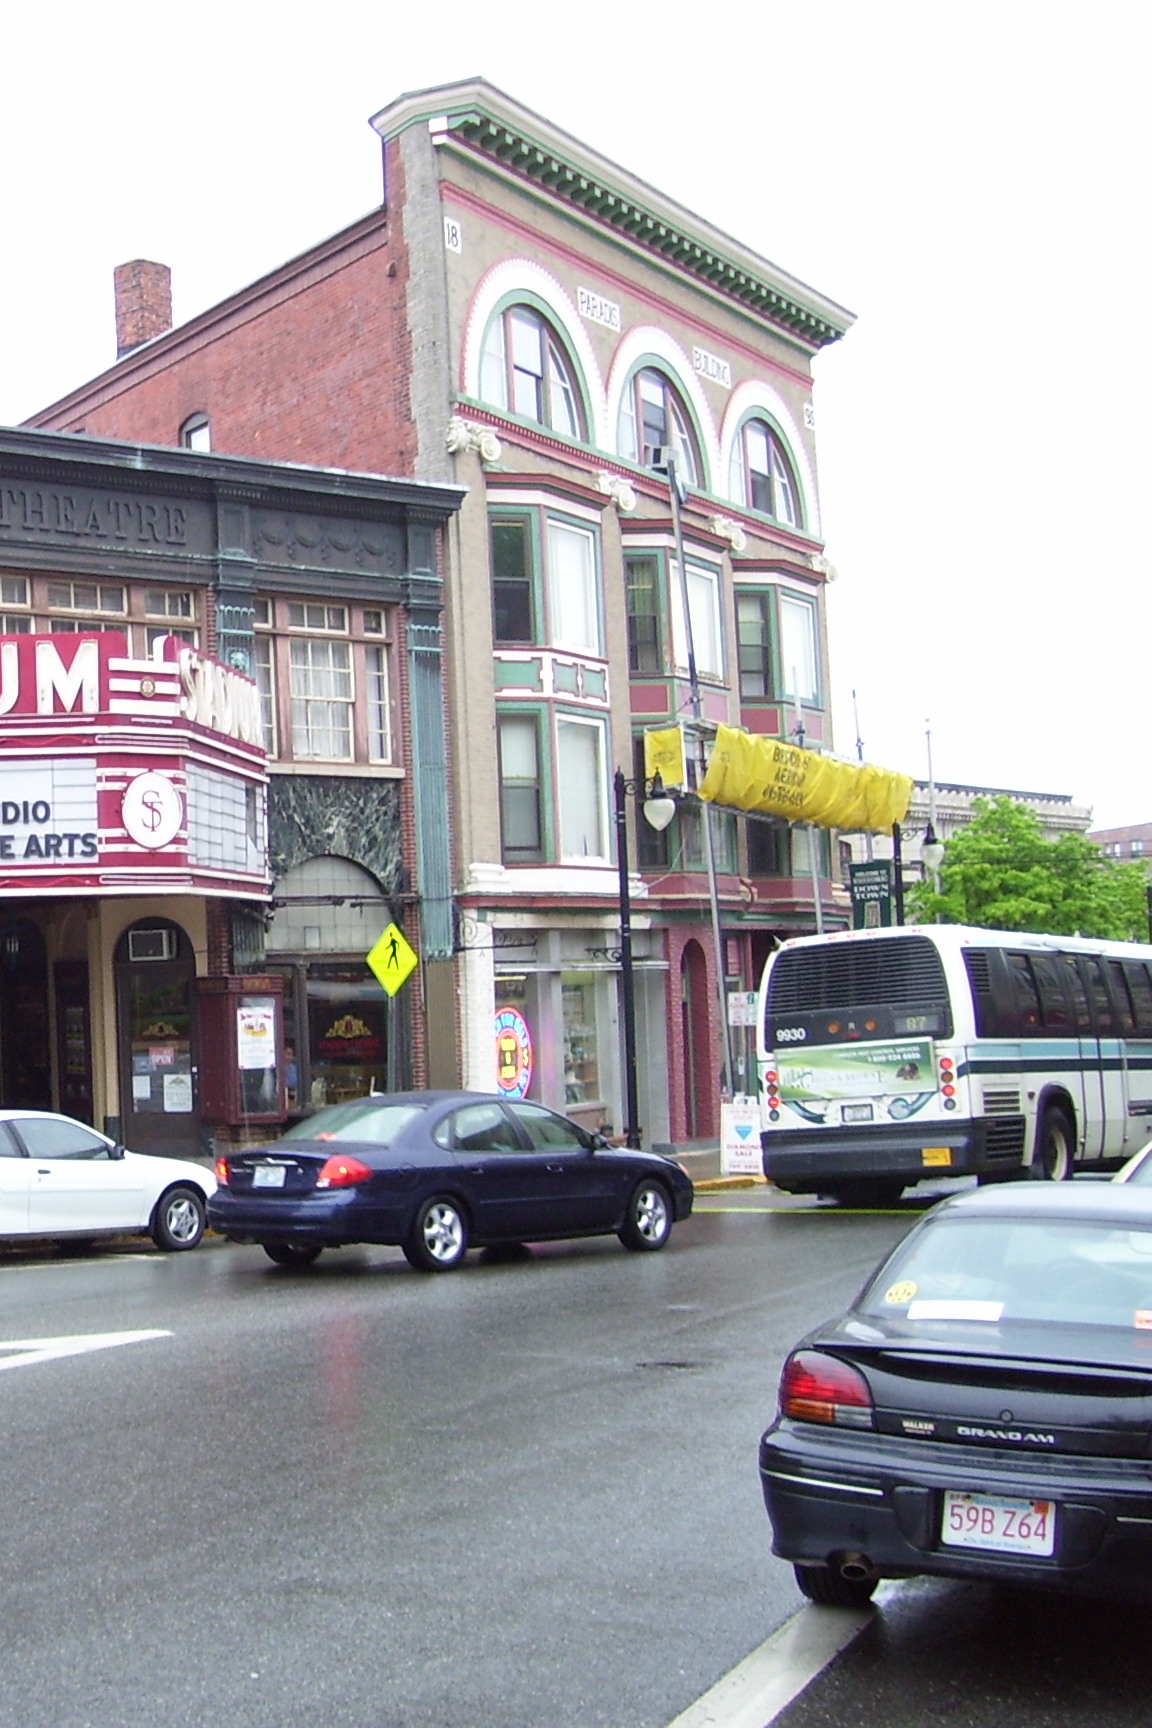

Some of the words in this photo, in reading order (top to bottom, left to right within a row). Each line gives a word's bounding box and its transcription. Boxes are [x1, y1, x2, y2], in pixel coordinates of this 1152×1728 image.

[447, 222, 459, 248] 18
[580, 290, 619, 329] PARADIS
[23, 832, 98, 859] ARTS
[776, 1027, 806, 1042] 9930
[956, 1426, 1023, 1441] GRAND
[1023, 1432, 1056, 1445] AM
[949, 1504, 995, 1535] 59B
[1002, 1509, 1047, 1541] Z64
